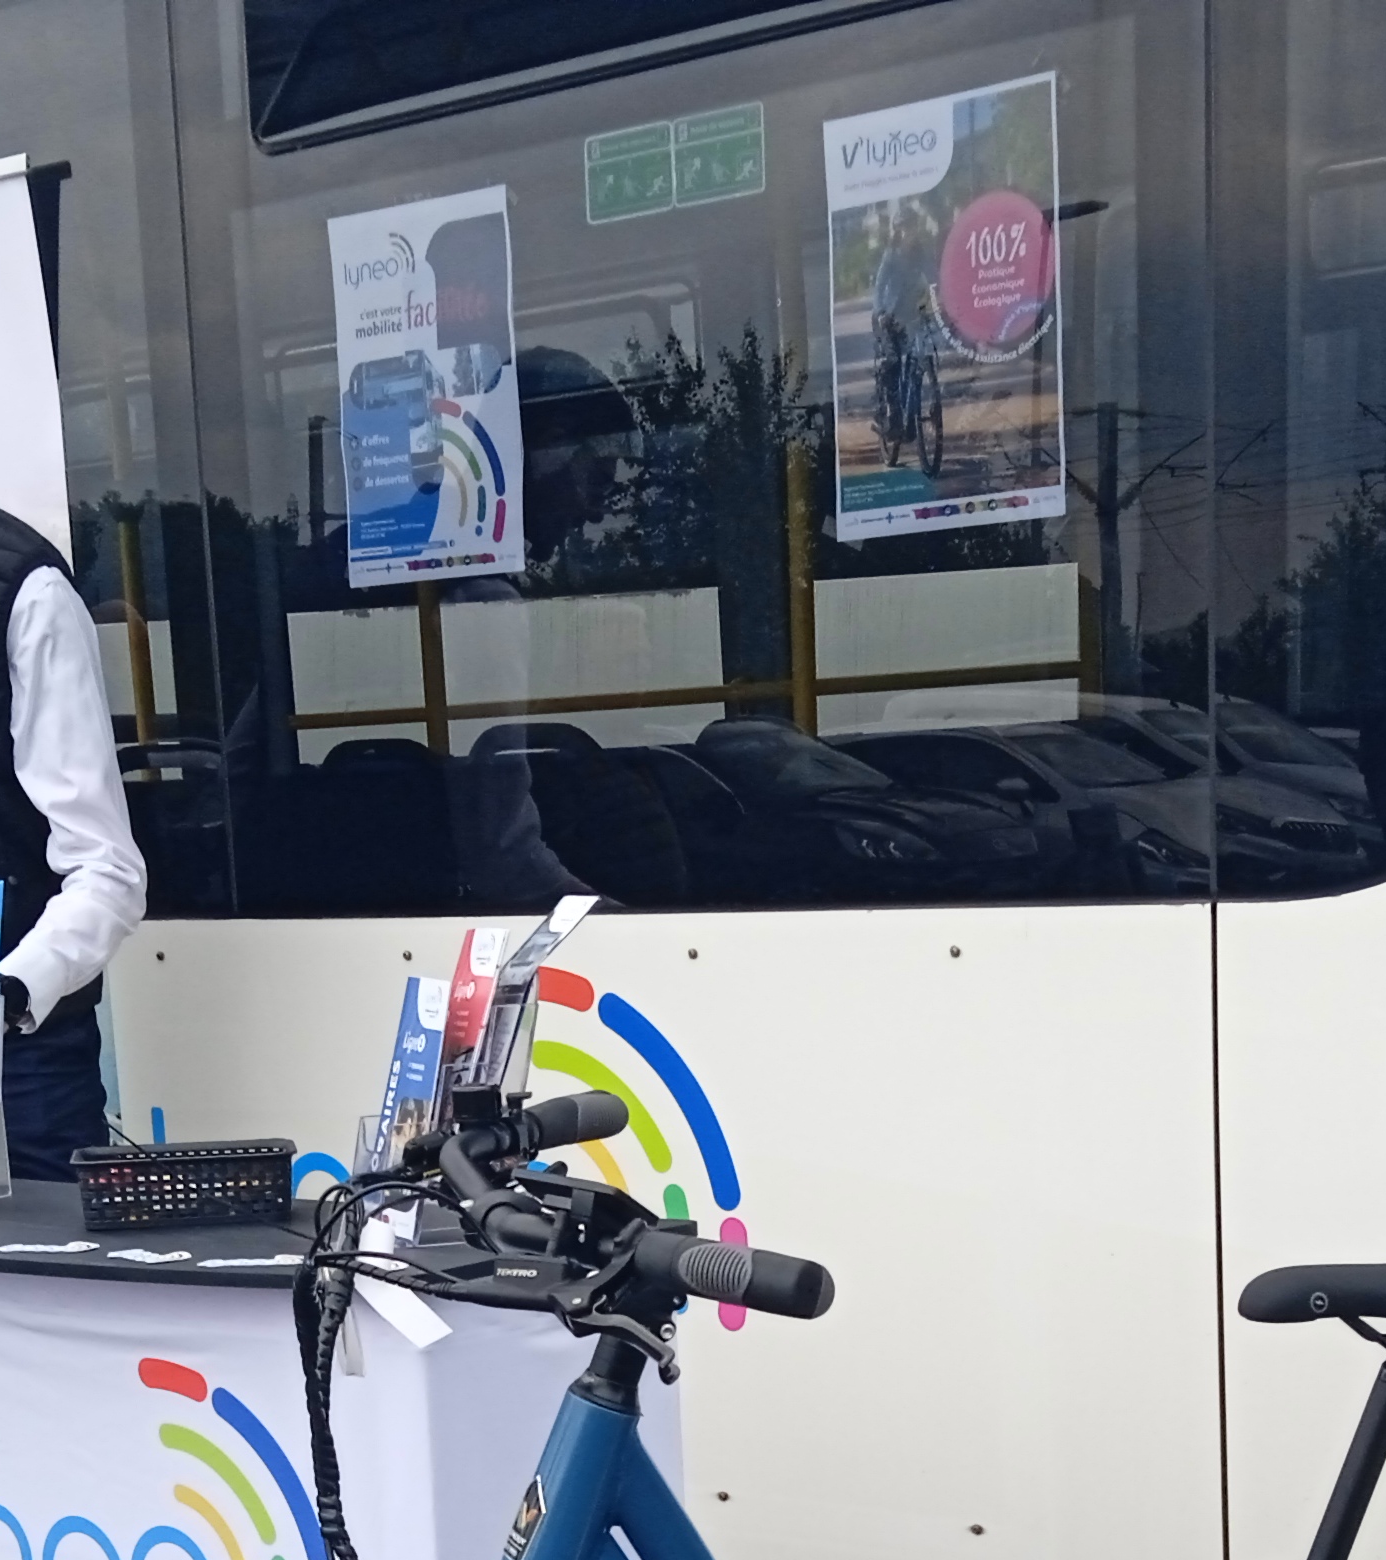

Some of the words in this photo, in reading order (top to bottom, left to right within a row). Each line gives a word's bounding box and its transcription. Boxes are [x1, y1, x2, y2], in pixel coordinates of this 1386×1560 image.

[966, 221, 1027, 268] 100%
[343, 257, 400, 290] lyneo
[355, 318, 403, 339] mobilité
[496, 1267, 538, 1278] TEKTRO
